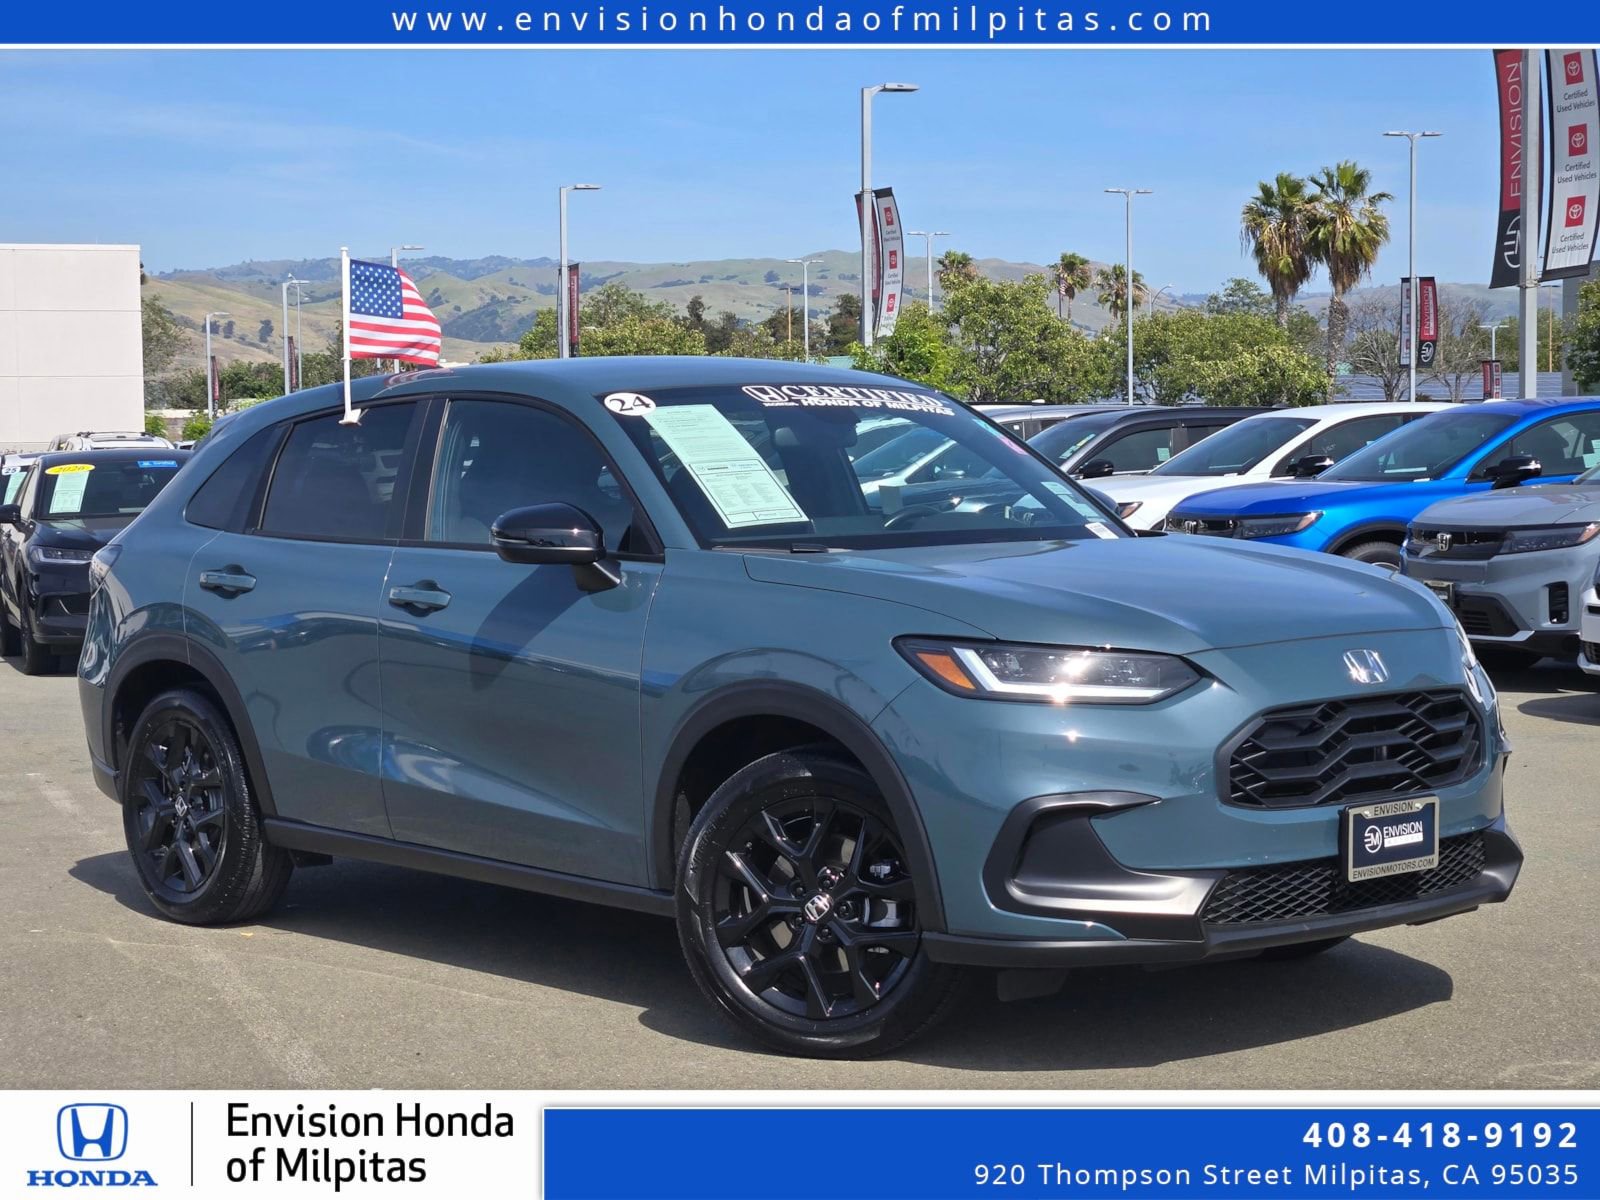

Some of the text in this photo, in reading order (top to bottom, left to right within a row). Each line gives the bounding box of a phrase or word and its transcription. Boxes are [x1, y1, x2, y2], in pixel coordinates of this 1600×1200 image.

[1563, 88, 1588, 101] Certified
[1556, 99, 1596, 113] Used Vehicles
[1564, 161, 1590, 172] Certified
[1557, 171, 1597, 184] Used Vehicles
[1560, 232, 1585, 243] Certified
[1552, 243, 1589, 254] Used Vehicles
[609, 395, 651, 412] 24
[781, 385, 945, 408] CERTIFIED
[801, 398, 956, 416] HONDA OF MILPITAS
[1373, 801, 1414, 816] ENVISION
[1383, 821, 1423, 838] ENVISION
[1352, 858, 1435, 880] ENVISIONMOTORS.COM
